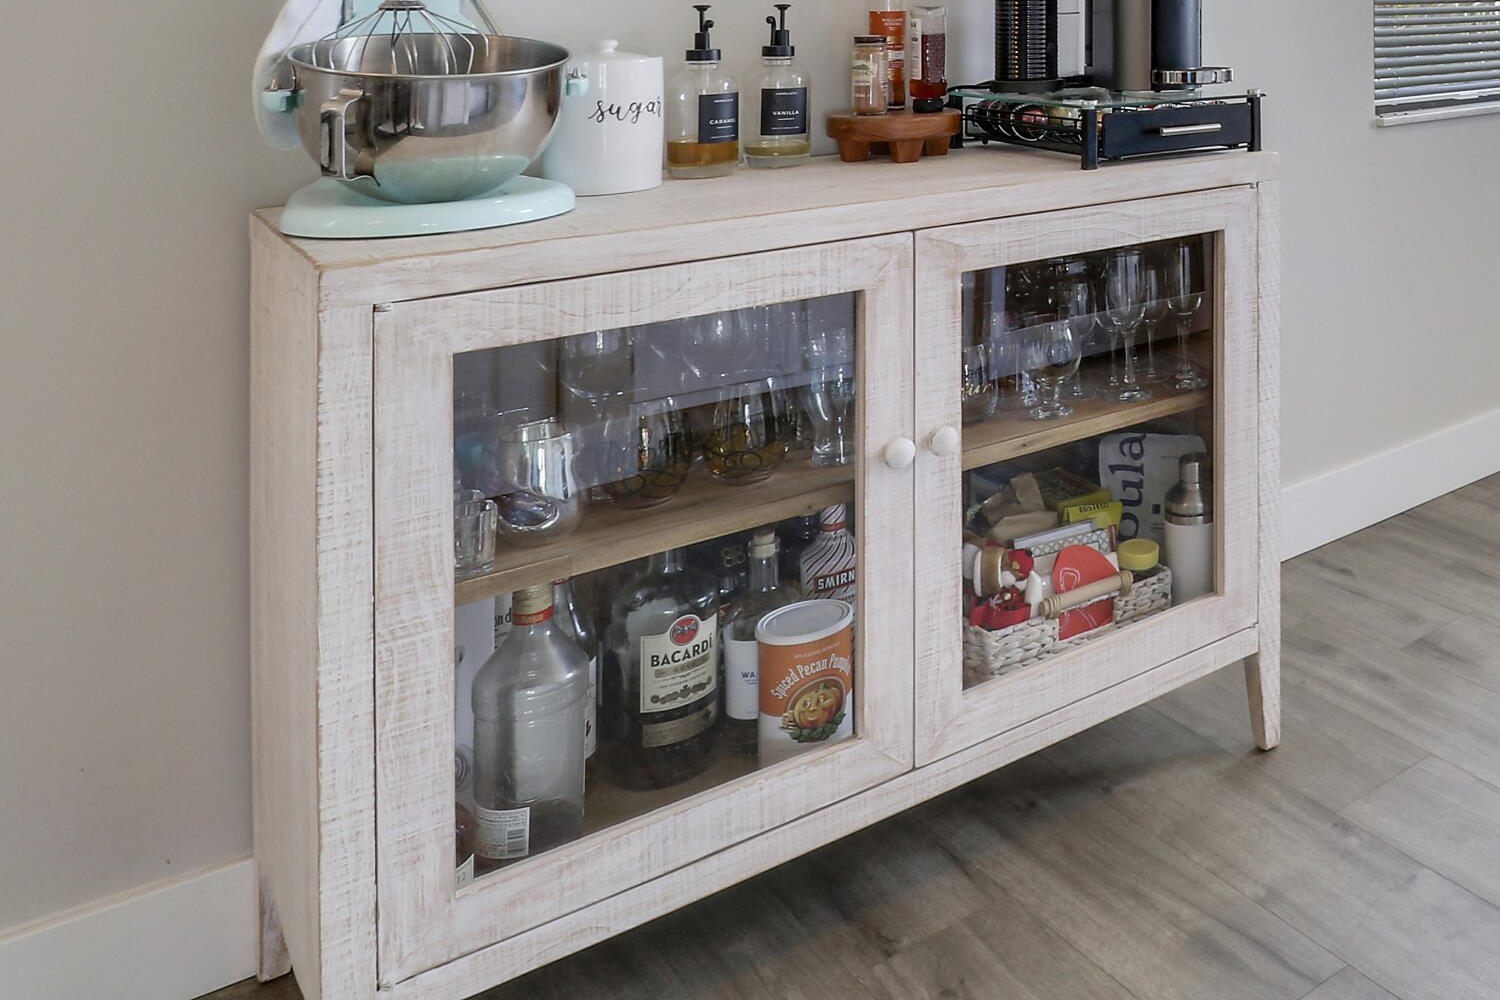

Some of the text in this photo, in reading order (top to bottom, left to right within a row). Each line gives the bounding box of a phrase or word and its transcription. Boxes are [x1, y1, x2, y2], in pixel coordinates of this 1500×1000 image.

[588, 96, 662, 124] sugar
[818, 569, 855, 590] SMIRN
[770, 669, 800, 700] Spiced
[796, 659, 827, 679] Pecan
